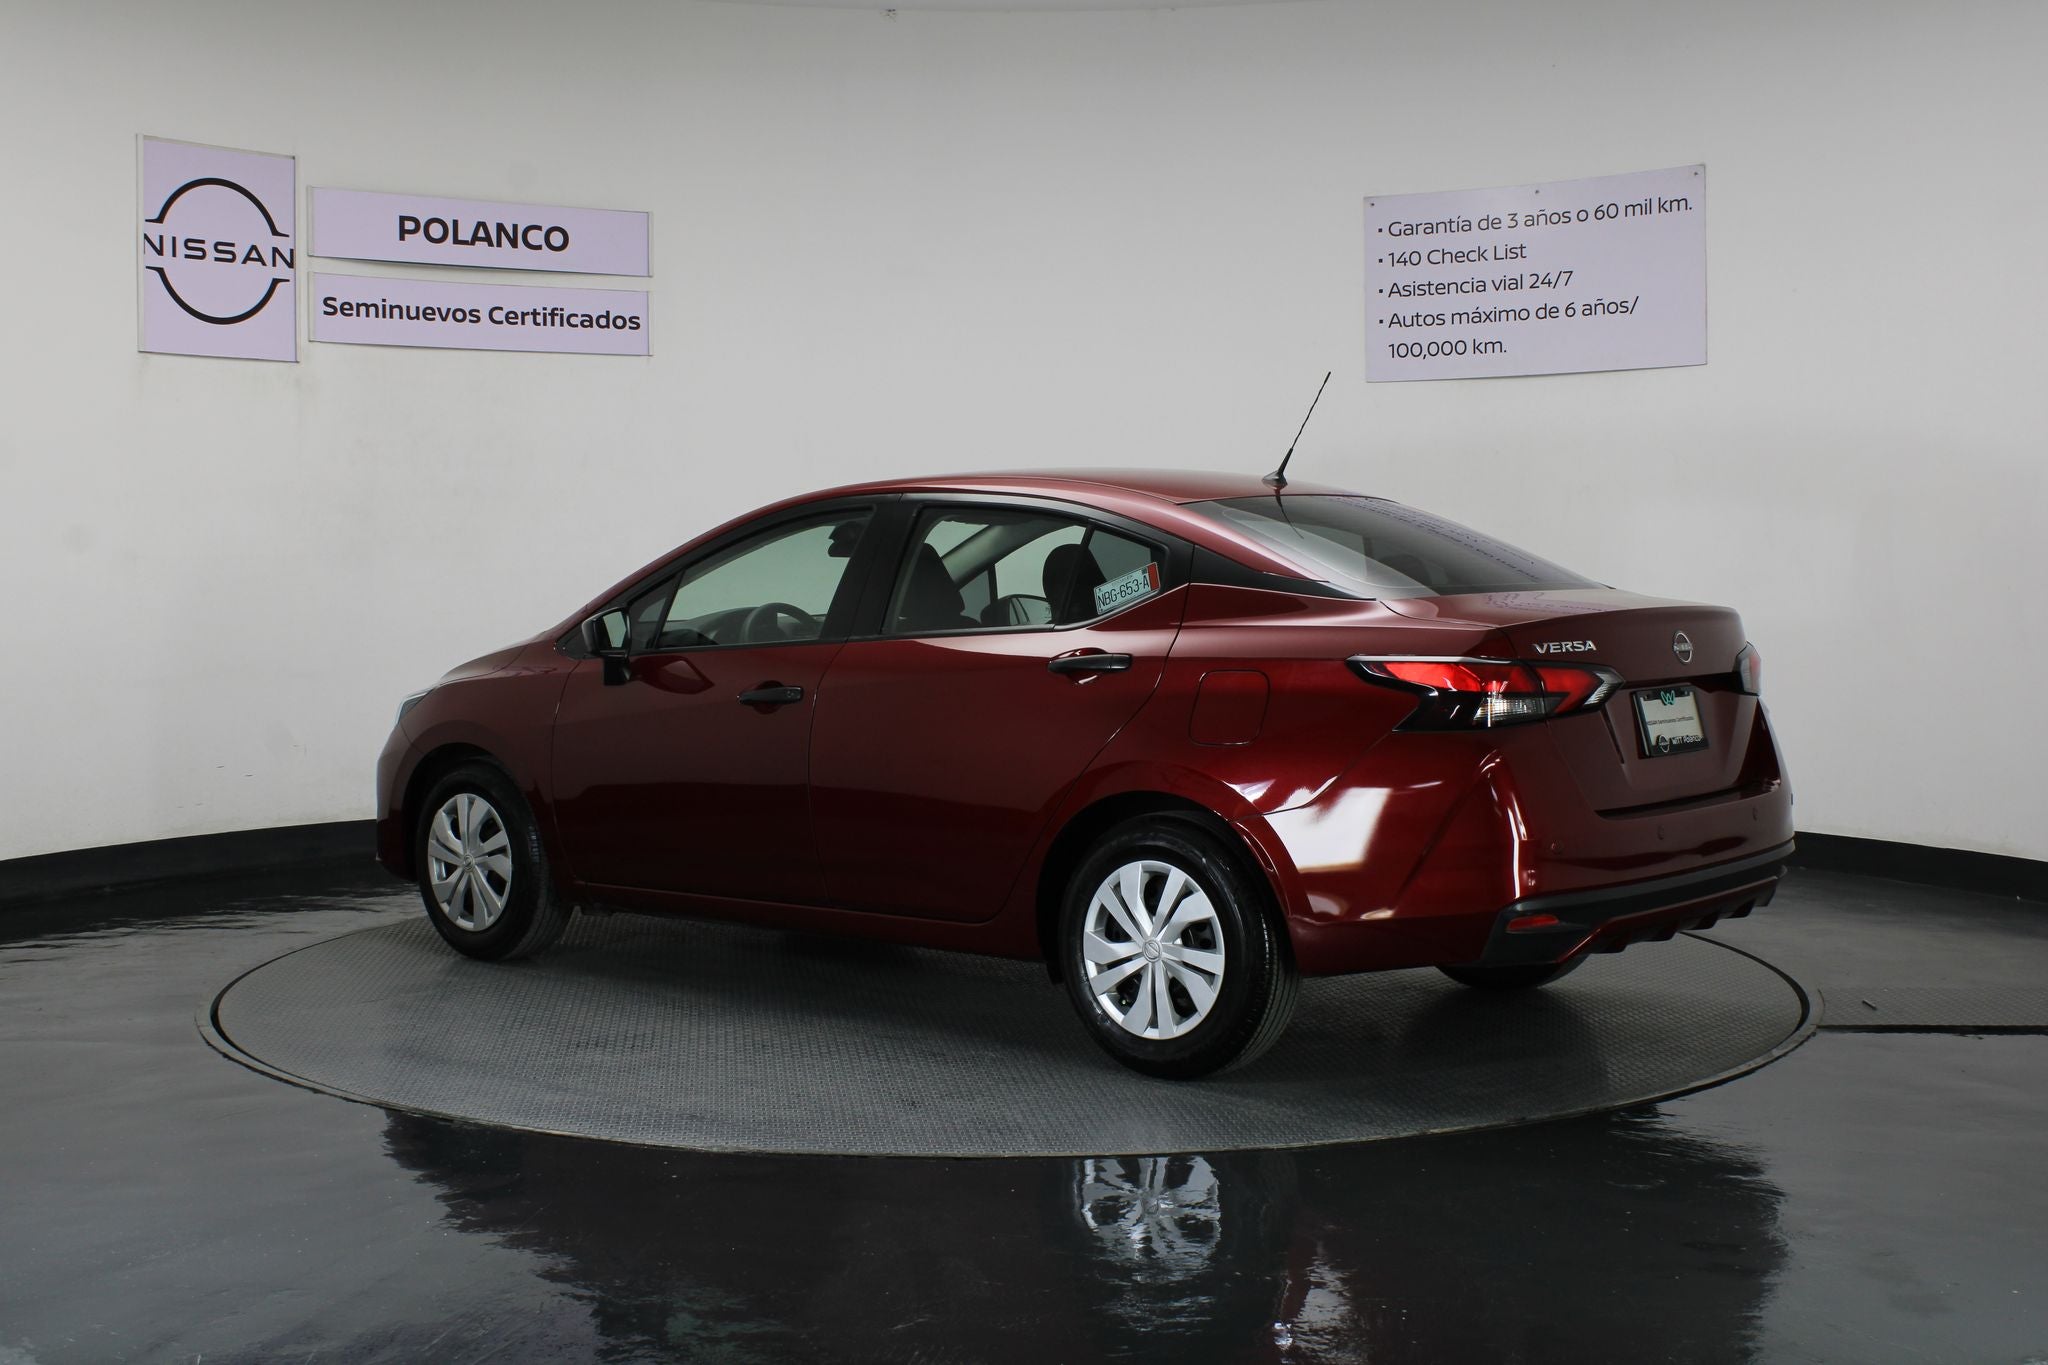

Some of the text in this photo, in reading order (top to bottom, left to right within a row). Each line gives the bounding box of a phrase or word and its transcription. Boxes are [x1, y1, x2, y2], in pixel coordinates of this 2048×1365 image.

[1389, 197, 1692, 236] Garantía de 3 años o 60 mil km.
[399, 216, 569, 251] POLANCO
[144, 232, 294, 269] NISSAN
[1389, 244, 1526, 267] 140 Check List
[1388, 271, 1573, 297] Asistencia vial 24/7
[323, 297, 640, 330] Seminuevos Certificados
[1389, 296, 1639, 328] Autos máximo de 6 años/
[1389, 339, 1506, 359] 100,000 km.
[1098, 575, 1149, 607] NBG-653-A
[1533, 640, 1597, 654] VERSA
